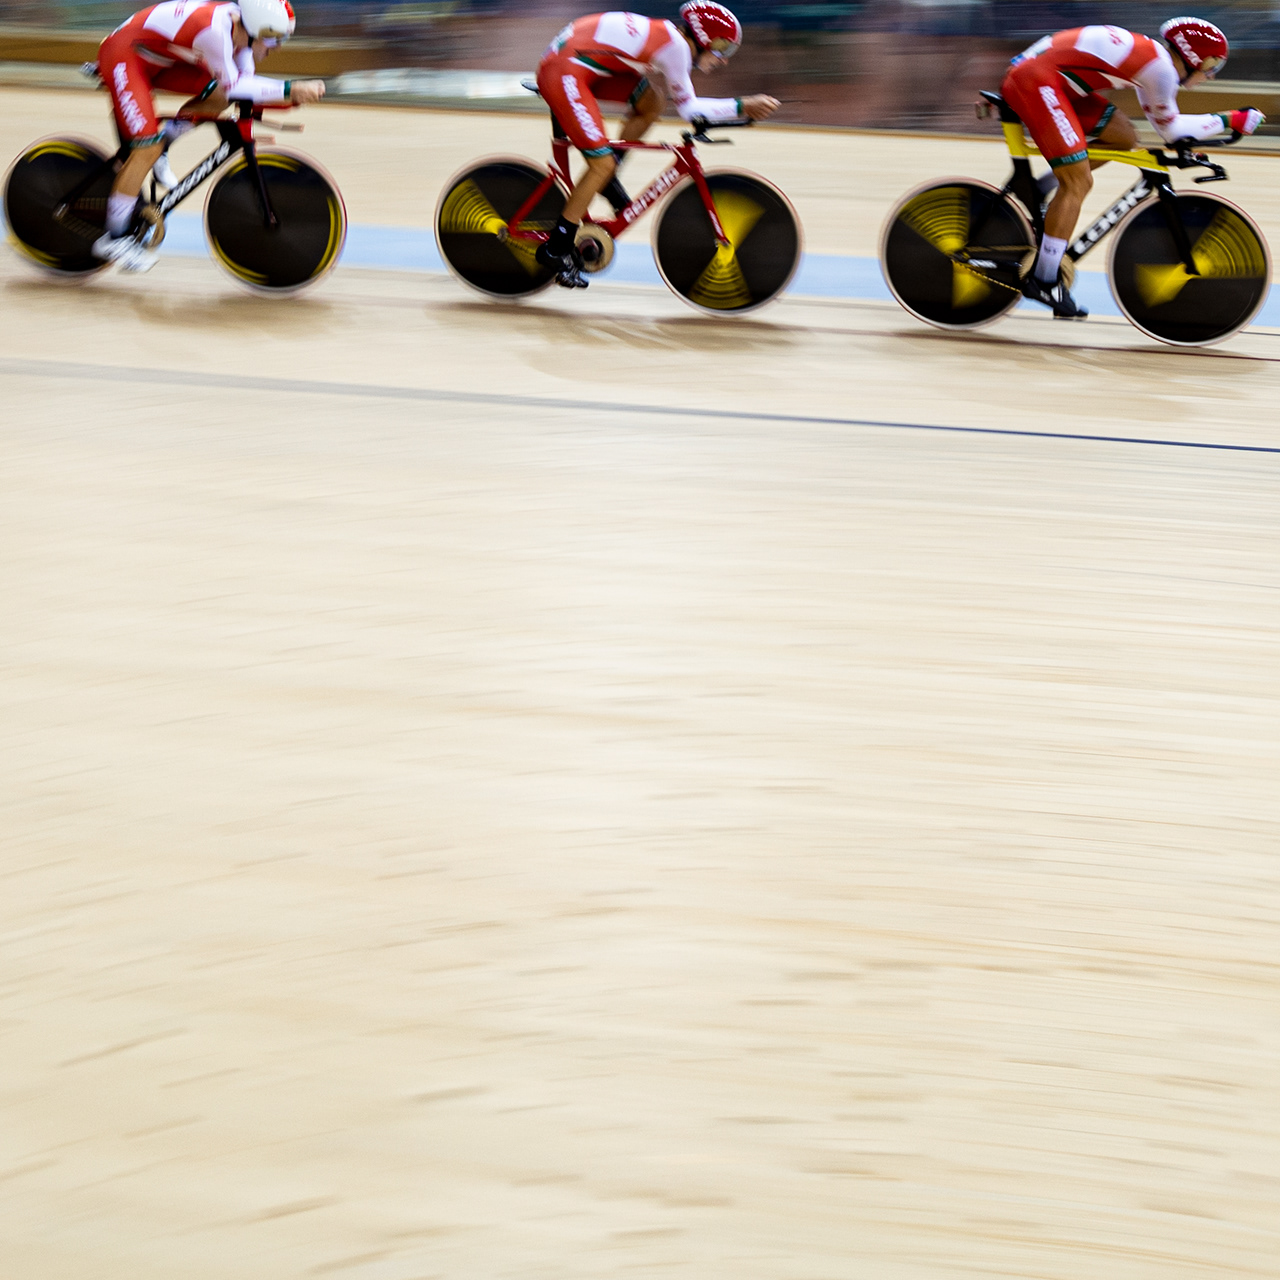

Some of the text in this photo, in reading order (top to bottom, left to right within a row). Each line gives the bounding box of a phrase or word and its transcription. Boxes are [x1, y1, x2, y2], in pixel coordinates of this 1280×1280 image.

[562, 74, 605, 142] BELARUS
[1038, 85, 1080, 148] BELARUS
[1073, 179, 1150, 254] LOOK
